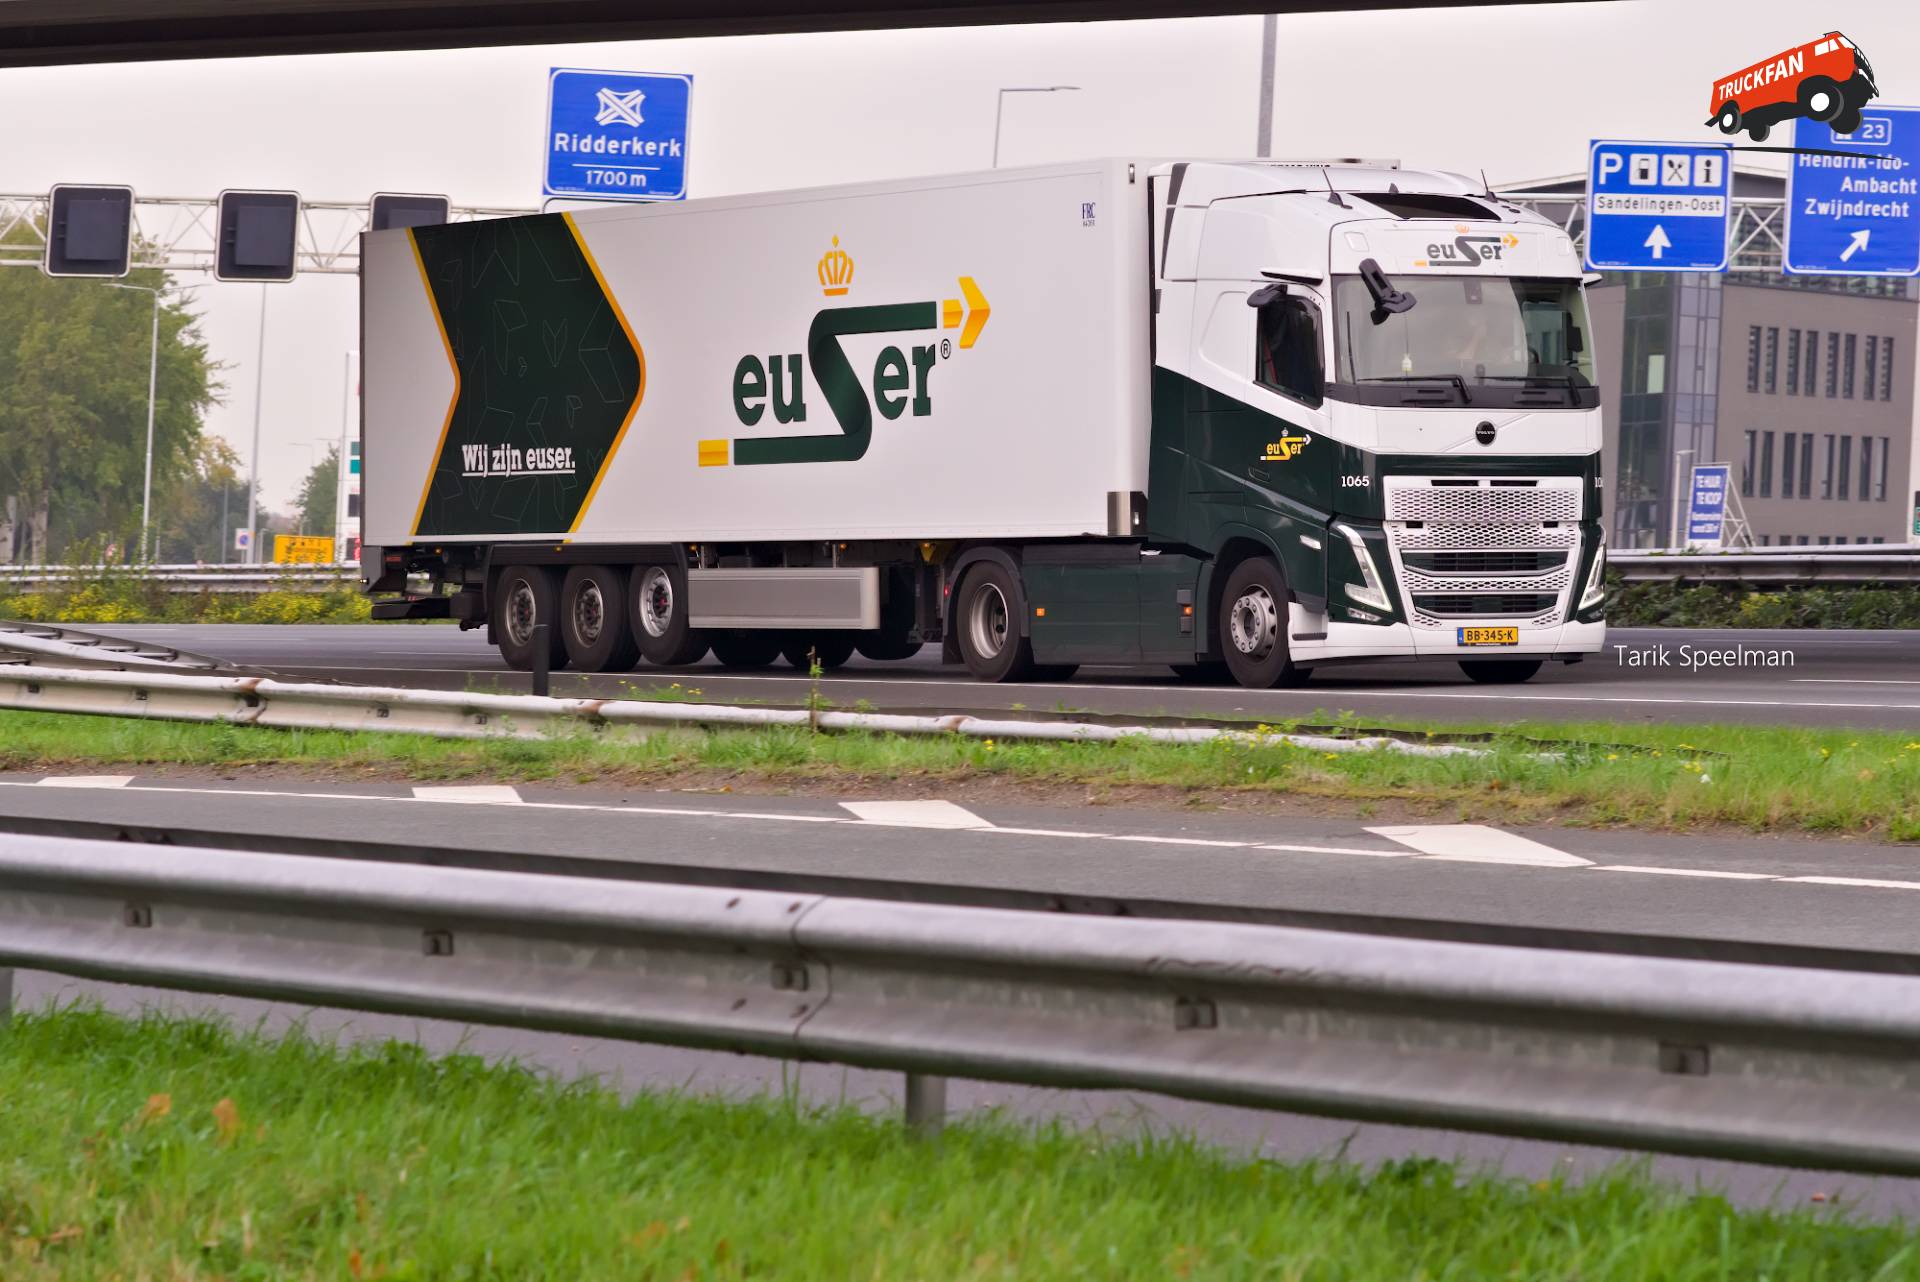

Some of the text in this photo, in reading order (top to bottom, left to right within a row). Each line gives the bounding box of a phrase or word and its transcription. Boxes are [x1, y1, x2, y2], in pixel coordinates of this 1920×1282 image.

[1862, 124, 1886, 139] 23
[554, 132, 682, 158] Ridderkerk
[586, 170, 647, 187] 1700 m
[1840, 176, 1918, 195] Ambacht
[1597, 196, 1721, 214] Sandelingen-Oost
[1804, 198, 1910, 221] Zwijndrecht
[462, 443, 576, 478] Wij zijn euser.
[1341, 475, 1370, 488] 1065
[1466, 630, 1514, 641] BB-345-K
